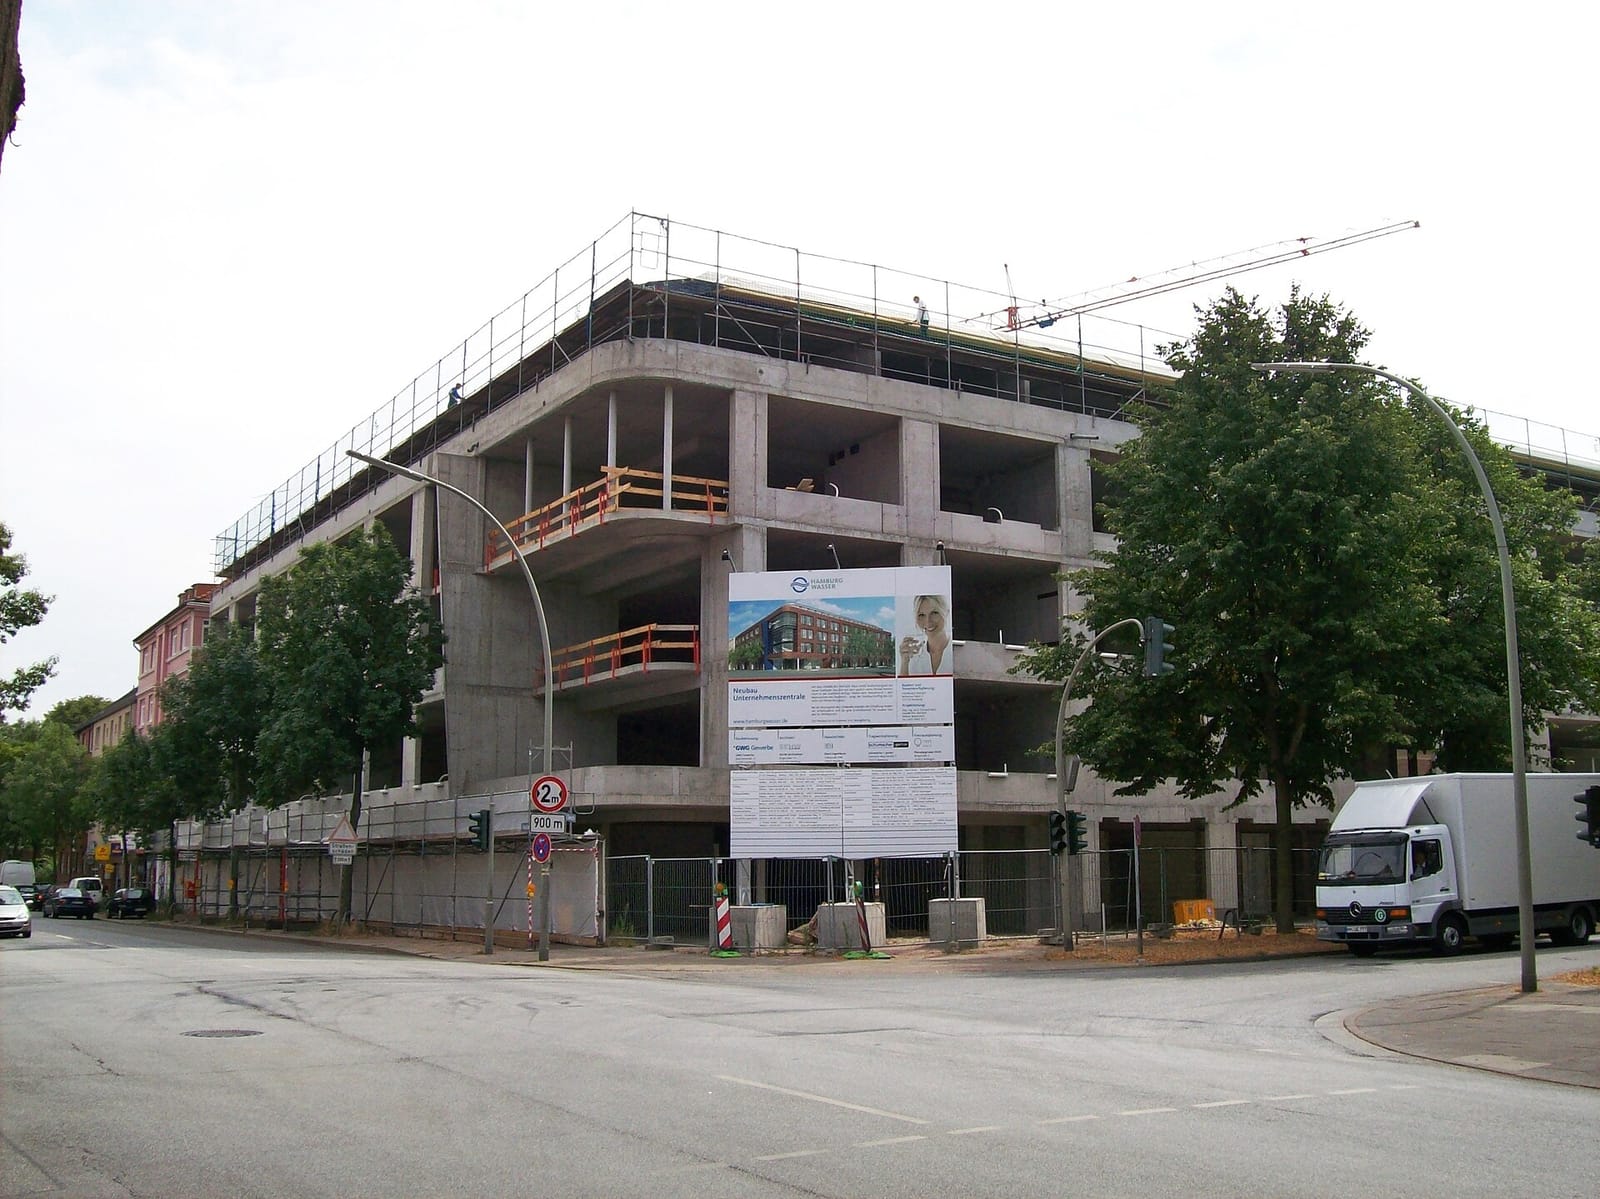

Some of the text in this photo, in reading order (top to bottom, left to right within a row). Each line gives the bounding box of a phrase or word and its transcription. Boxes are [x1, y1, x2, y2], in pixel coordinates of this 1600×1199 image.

[733, 693, 806, 702] Unternehmenszentrale
[541, 784, 551, 803] 2
[534, 817, 562, 829] 900 m
[1377, 911, 1384, 920] G
